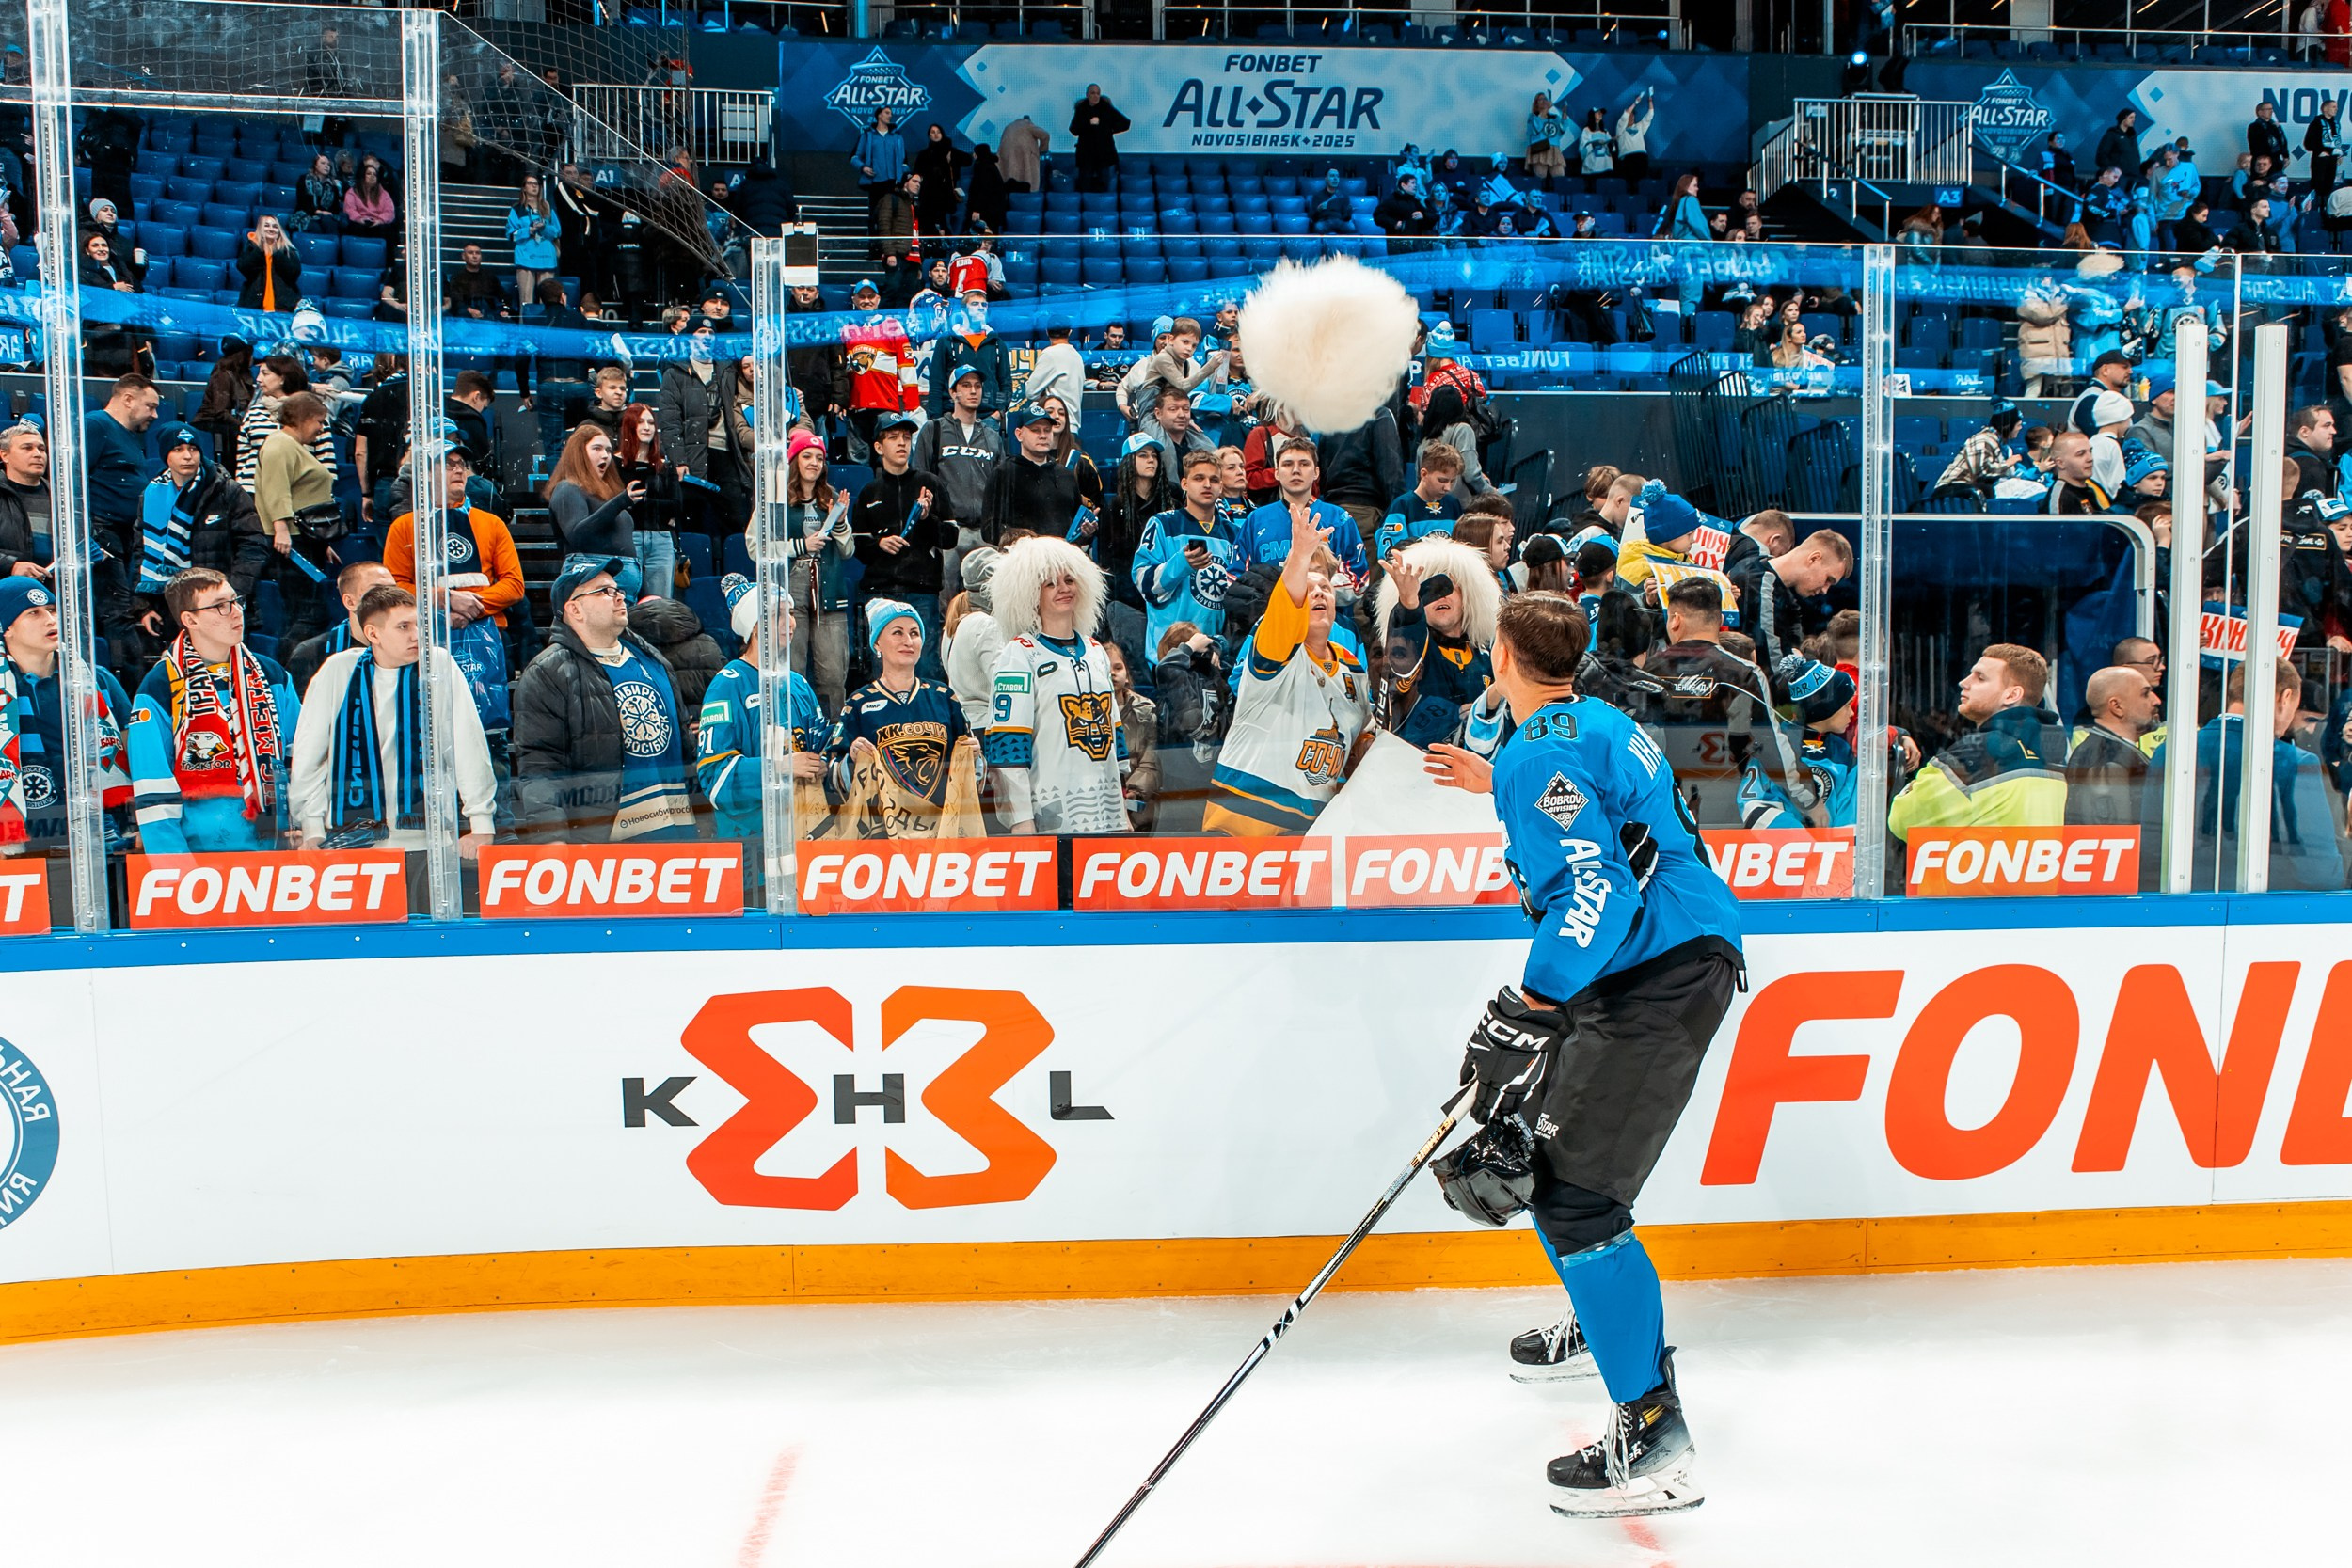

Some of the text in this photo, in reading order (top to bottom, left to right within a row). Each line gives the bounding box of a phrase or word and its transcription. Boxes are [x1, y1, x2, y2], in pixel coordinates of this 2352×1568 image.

[1224, 54, 1323, 73] FONBET
[859, 75, 895, 85] FONBET
[1990, 97, 2023, 105] FONBET
[2263, 88, 2352, 123] NOV
[1191, 133, 1355, 148] NOVOSIBIRSK 2025
[595, 169, 614, 183] A1
[729, 173, 746, 187] A
[1938, 189, 1961, 203] A3
[941, 445, 994, 461] CCM
[1141, 522, 1158, 550] 4
[1523, 712, 1579, 742] 89
[1741, 766, 1758, 800] 2
[1541, 794, 1581, 807] BOBROV
[1549, 804, 1580, 813] DIVISION
[1078, 849, 1327, 898] FONBET
[1350, 846, 1512, 895] FONB
[1704, 841, 1849, 887] NBET
[1910, 838, 2135, 884] FONBET
[136, 863, 401, 916] FONBET
[486, 857, 738, 906] FONBET
[803, 851, 1052, 901] FONBET
